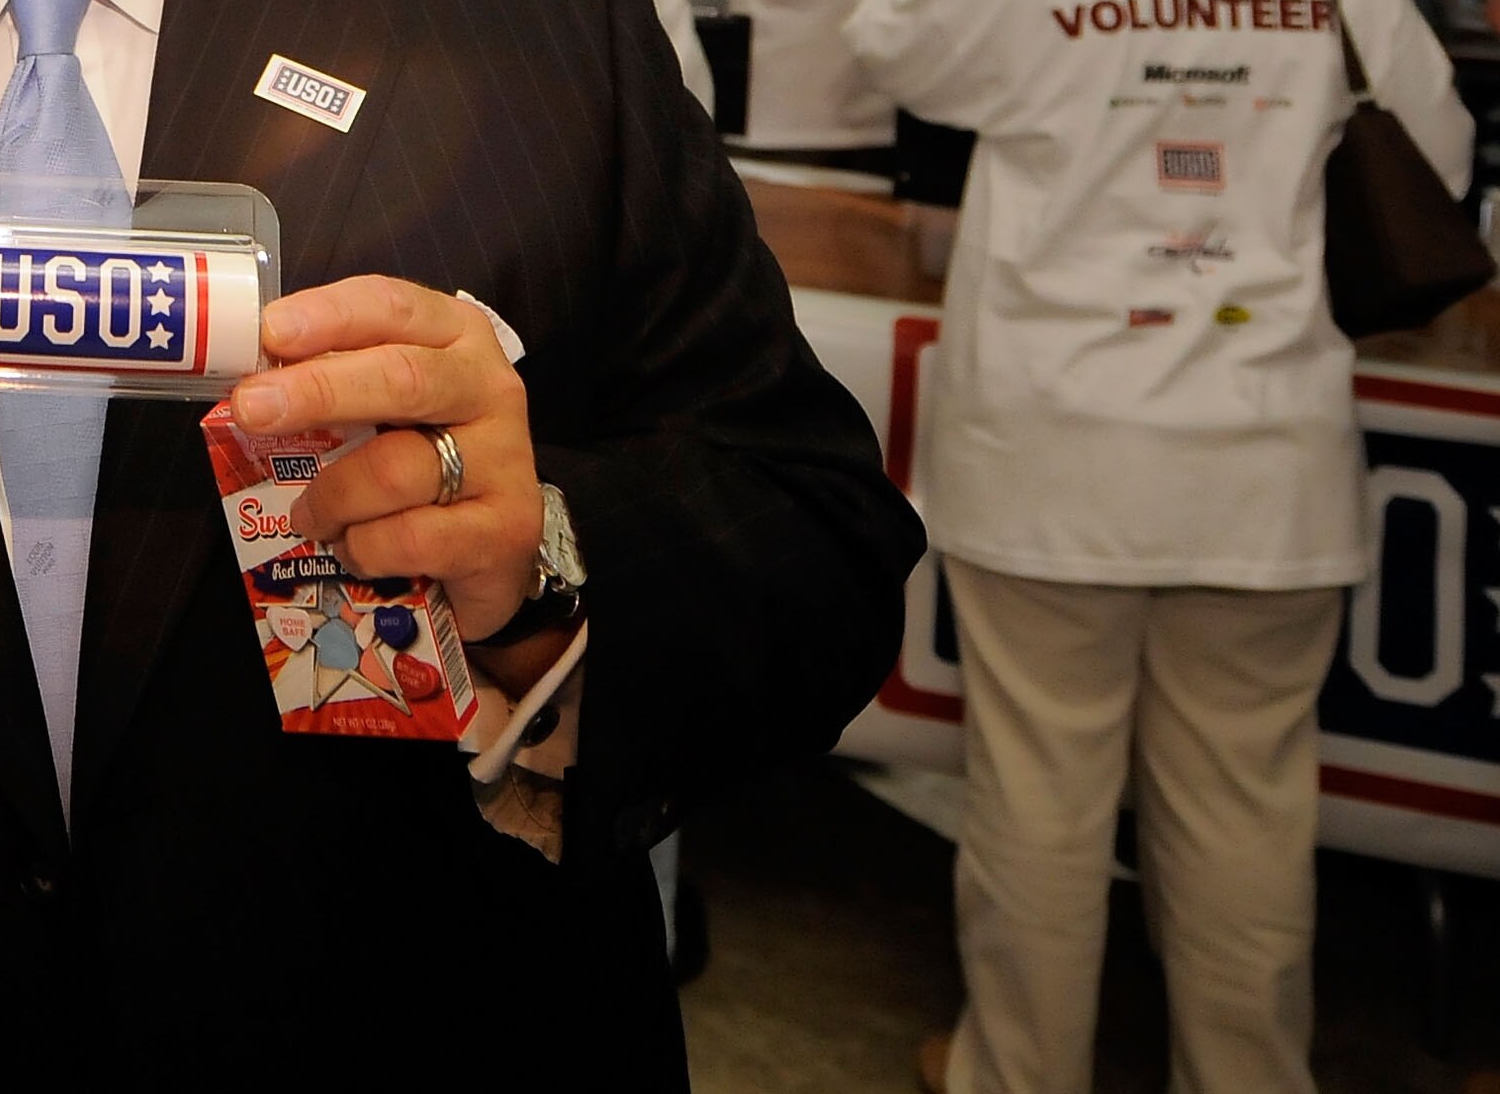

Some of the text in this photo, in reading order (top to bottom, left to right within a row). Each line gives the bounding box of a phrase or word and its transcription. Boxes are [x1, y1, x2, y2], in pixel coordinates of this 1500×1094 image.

[286, 73, 335, 109] USO
[279, 460, 312, 479] USO
[272, 562, 296, 581] Red
[299, 558, 336, 576] White
[280, 617, 306, 627] HOME
[380, 618, 400, 627] USO
[282, 626, 305, 636] SAFE
